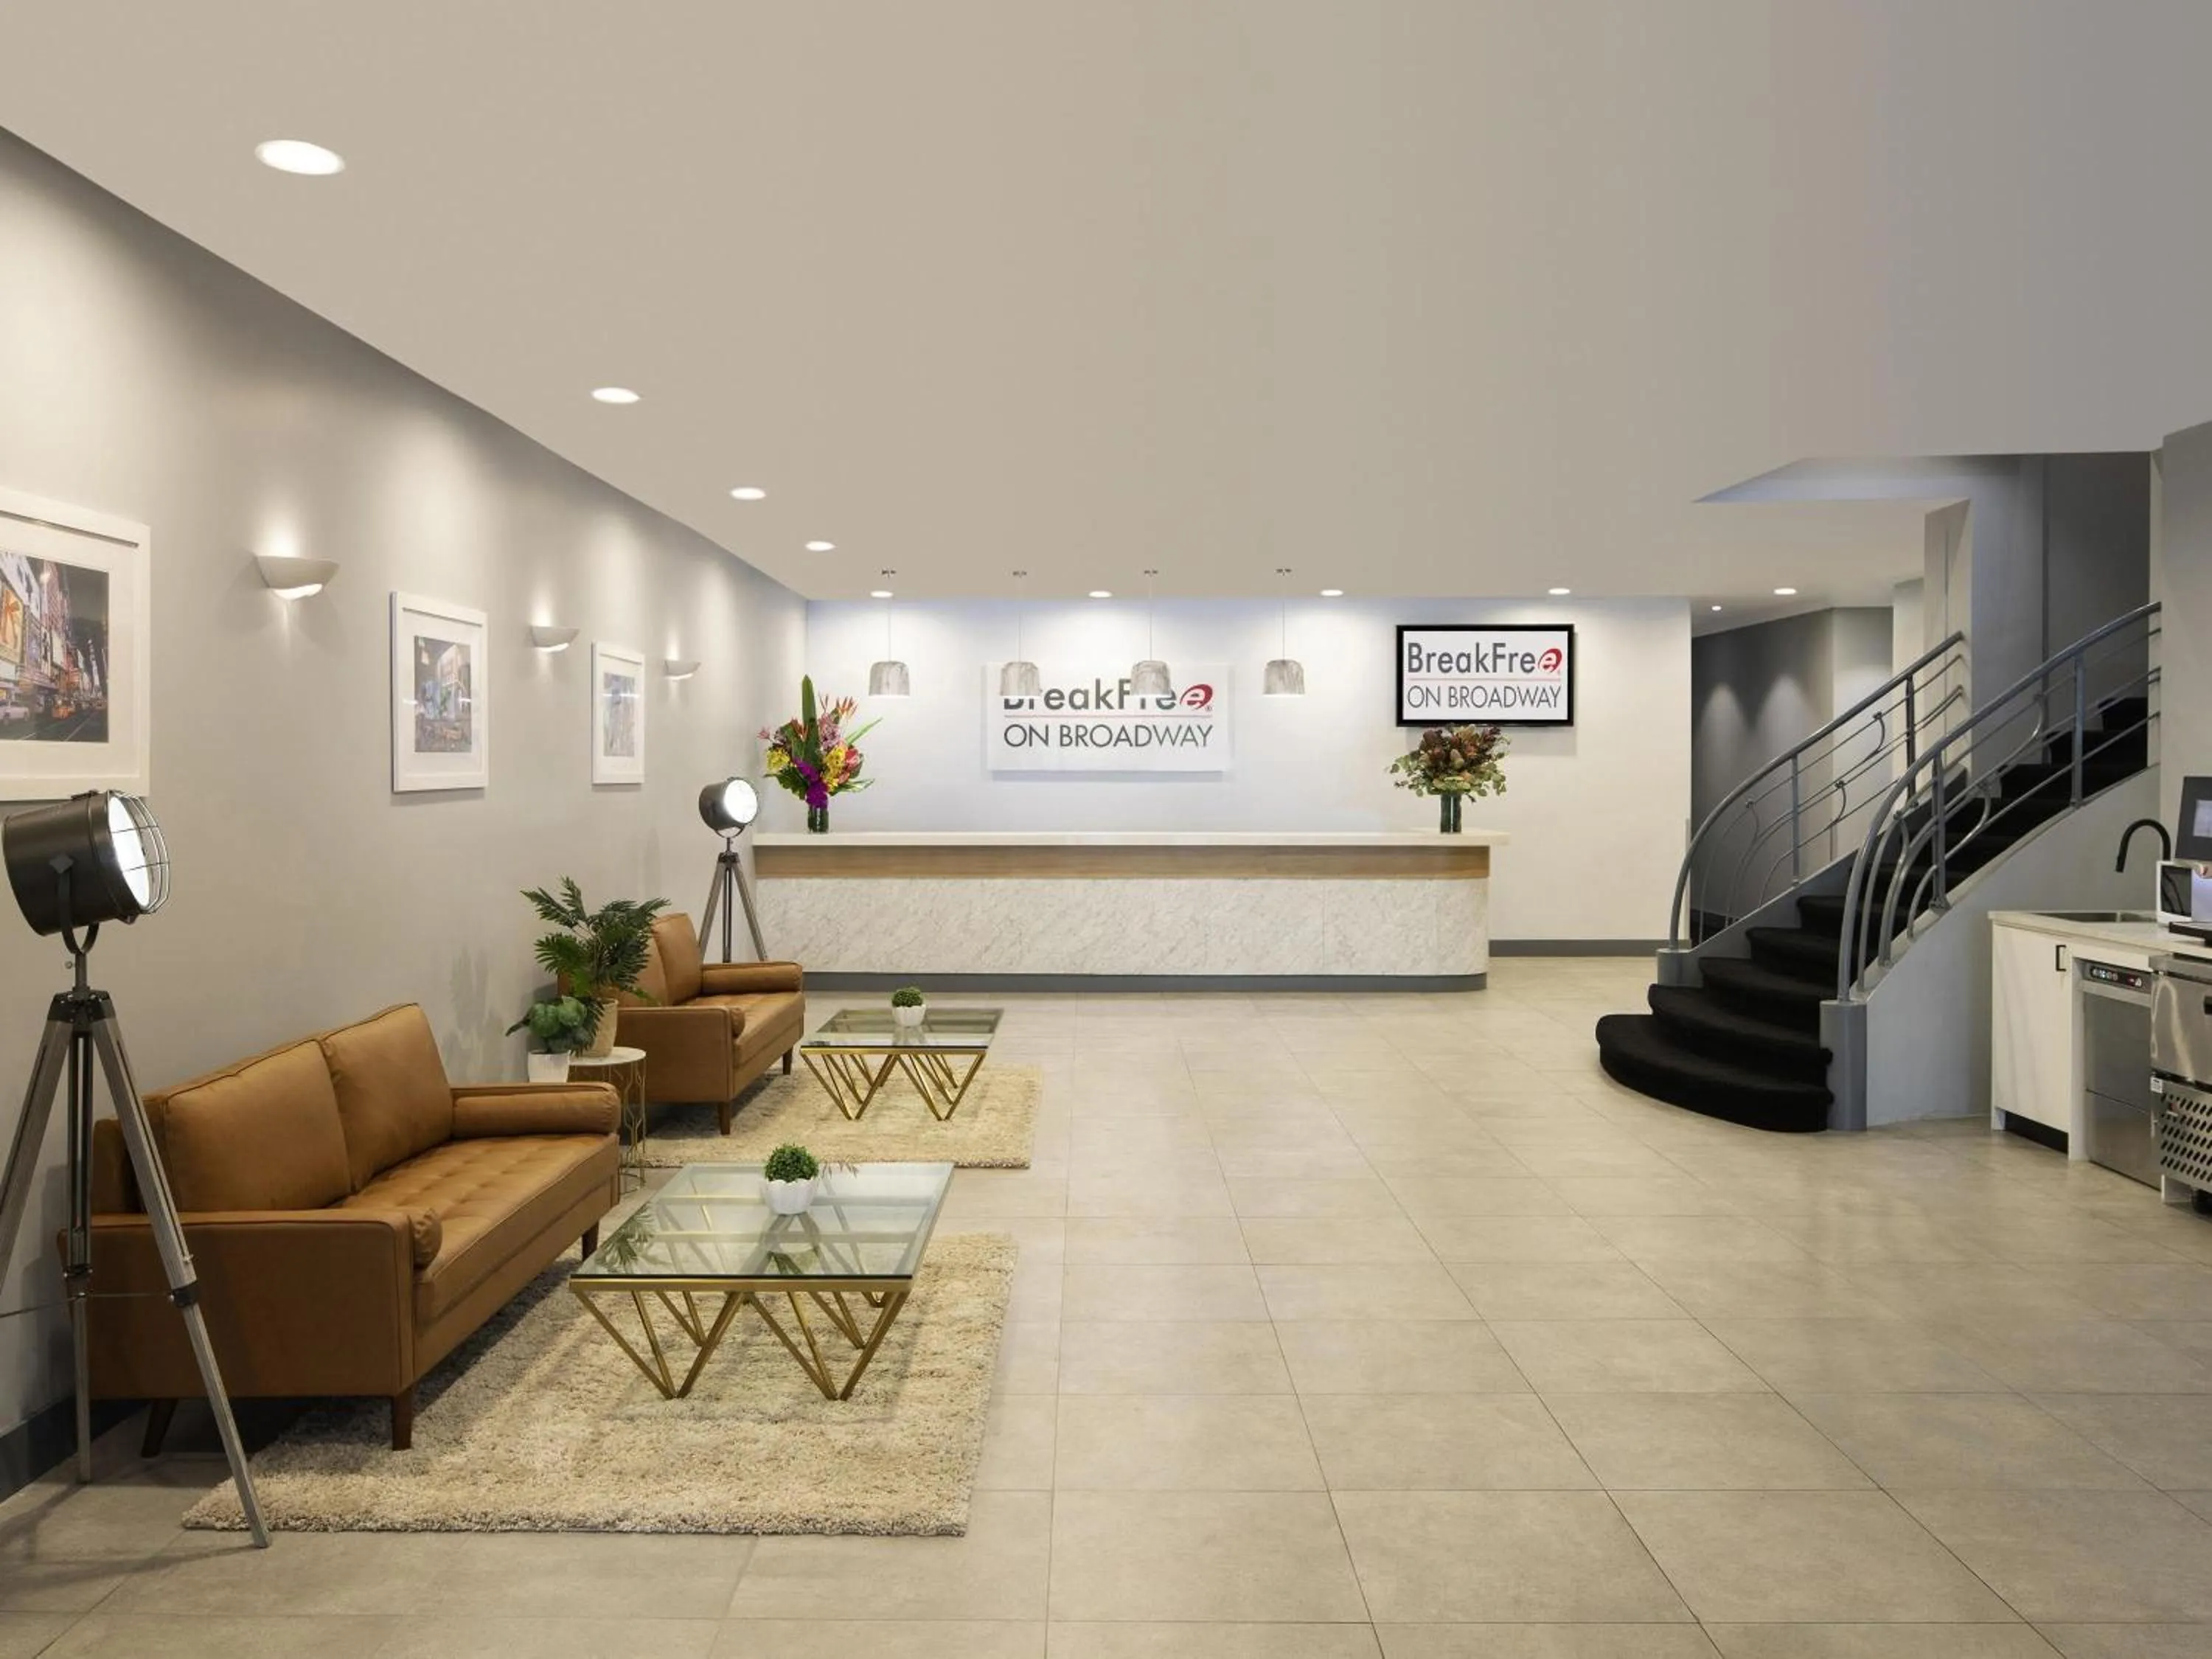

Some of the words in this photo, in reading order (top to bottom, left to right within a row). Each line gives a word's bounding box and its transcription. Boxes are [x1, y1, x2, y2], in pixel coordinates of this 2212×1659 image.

[1408, 641, 1563, 674] BreakFree
[1408, 685, 1441, 708] ON
[1448, 685, 1562, 708] BROADWAY
[1004, 723, 1049, 748] ON
[1059, 723, 1214, 748] BROADWAY
